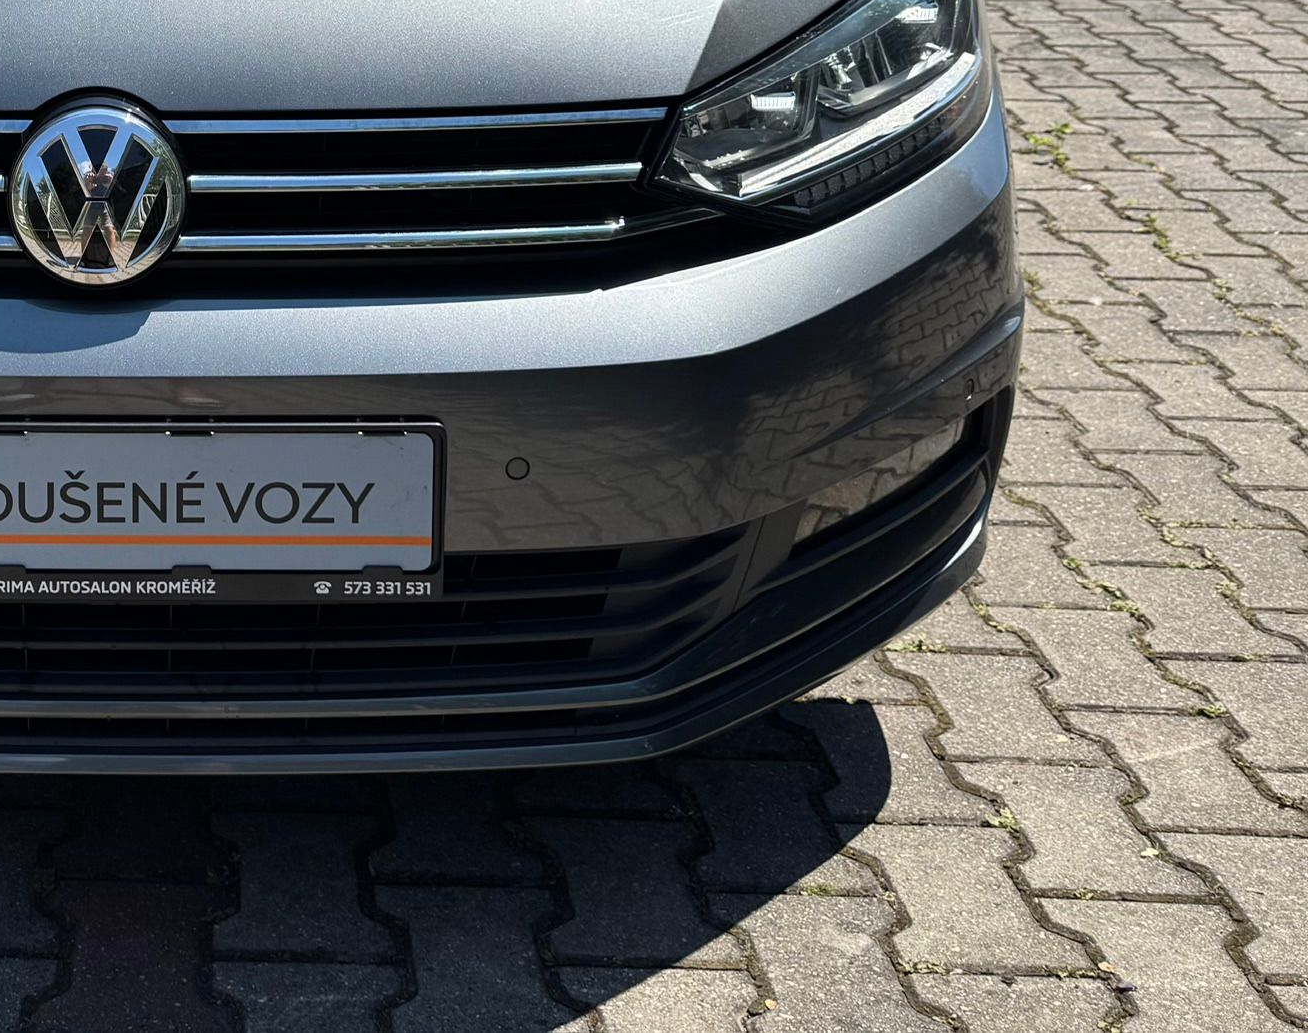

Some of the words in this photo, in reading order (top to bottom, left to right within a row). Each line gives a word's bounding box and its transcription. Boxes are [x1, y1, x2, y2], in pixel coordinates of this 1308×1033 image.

[215, 481, 376, 525] VOZY
[38, 579, 132, 595] AUTOSALON
[136, 578, 217, 595] KROMĚŘÍŽ
[343, 580, 372, 596] 573
[375, 580, 401, 596] 331
[405, 580, 432, 596] 531
